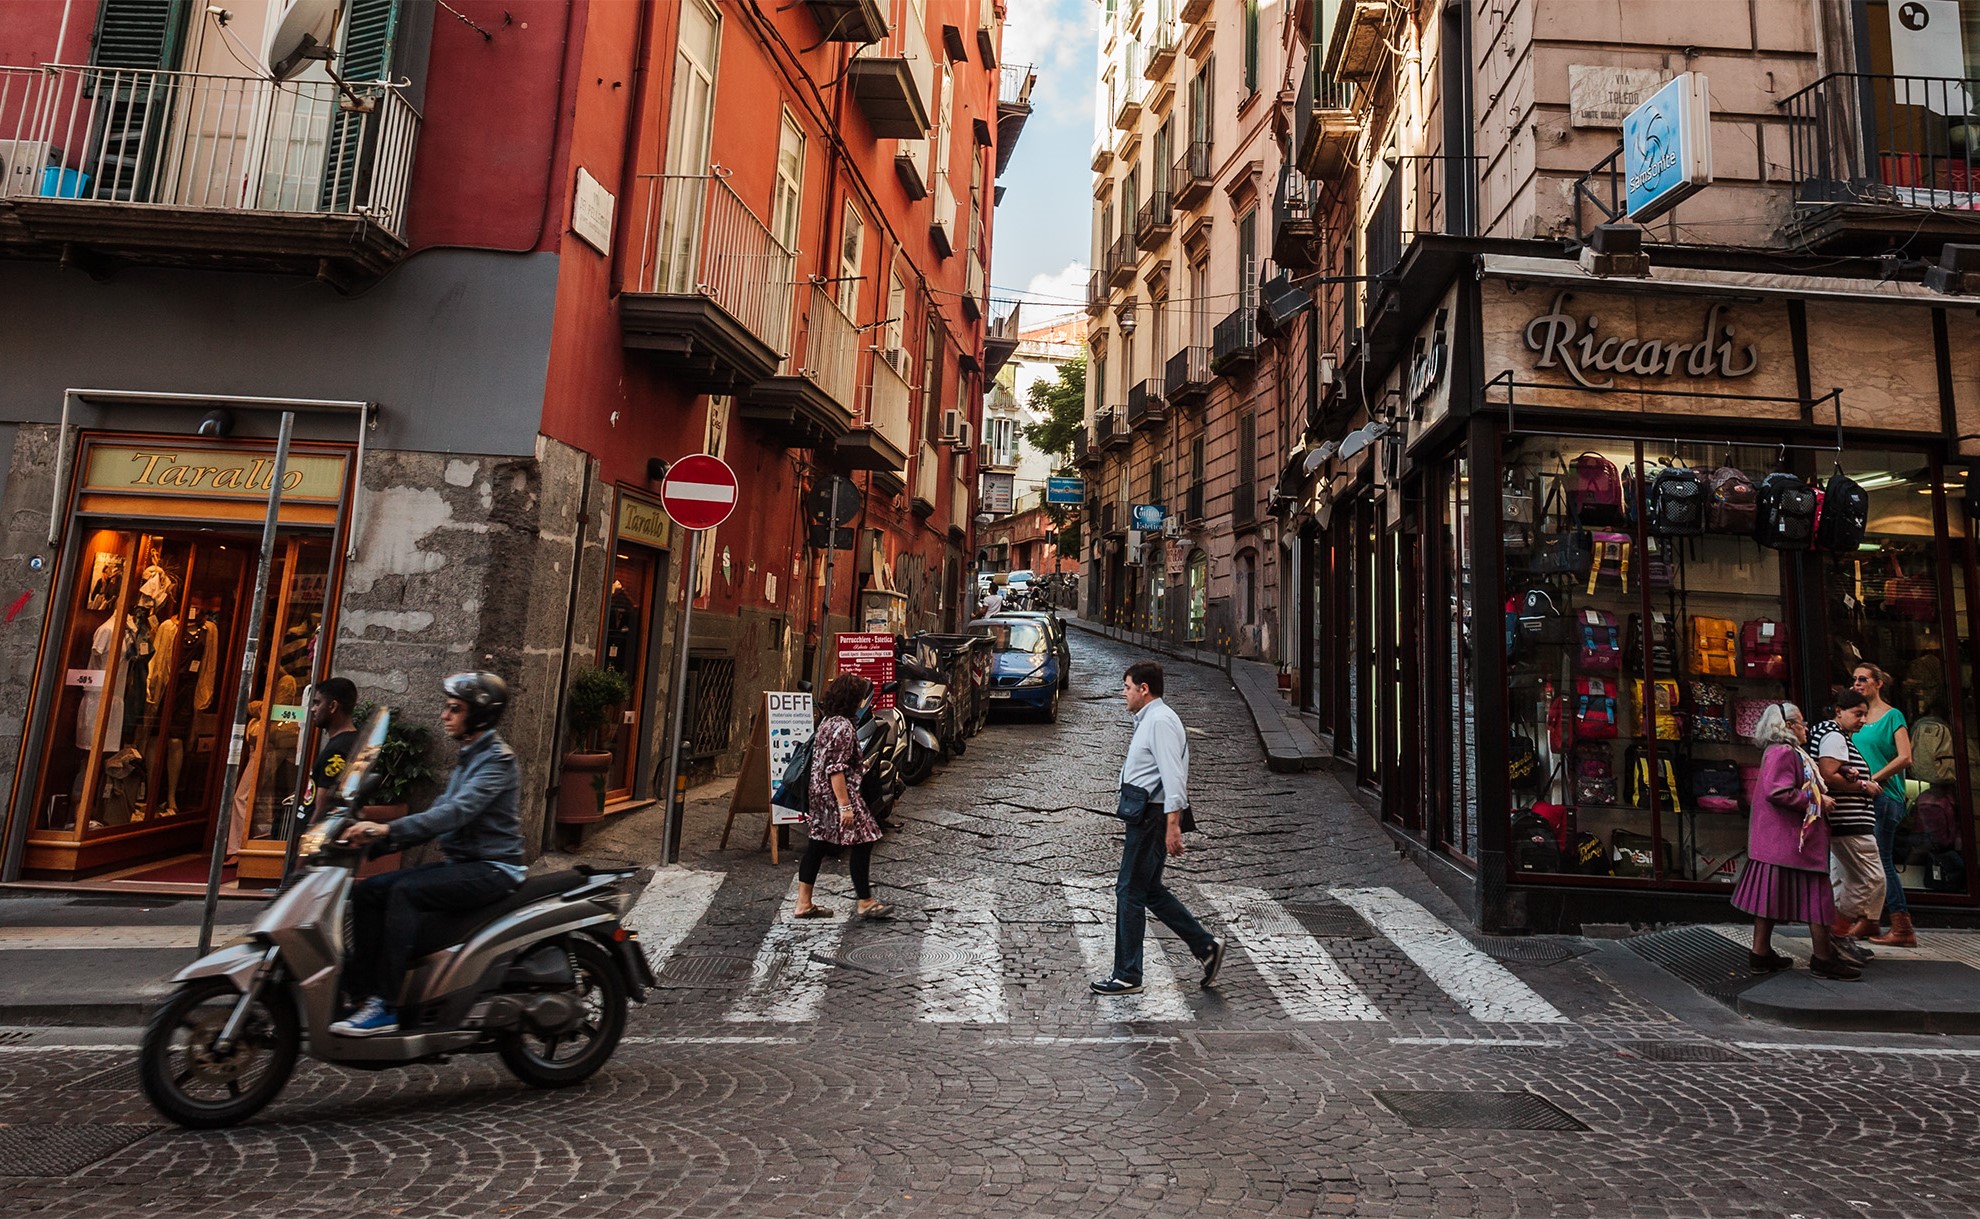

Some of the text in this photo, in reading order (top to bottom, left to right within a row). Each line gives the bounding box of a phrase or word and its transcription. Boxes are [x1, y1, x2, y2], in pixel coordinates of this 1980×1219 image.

[1615, 75, 1630, 85] VIA
[1608, 91, 1639, 105] TOLEDO
[1524, 290, 1757, 391] Riccardi
[131, 452, 304, 492] Tarallo
[625, 504, 663, 538] Tarallo
[770, 695, 811, 710] DEFF
